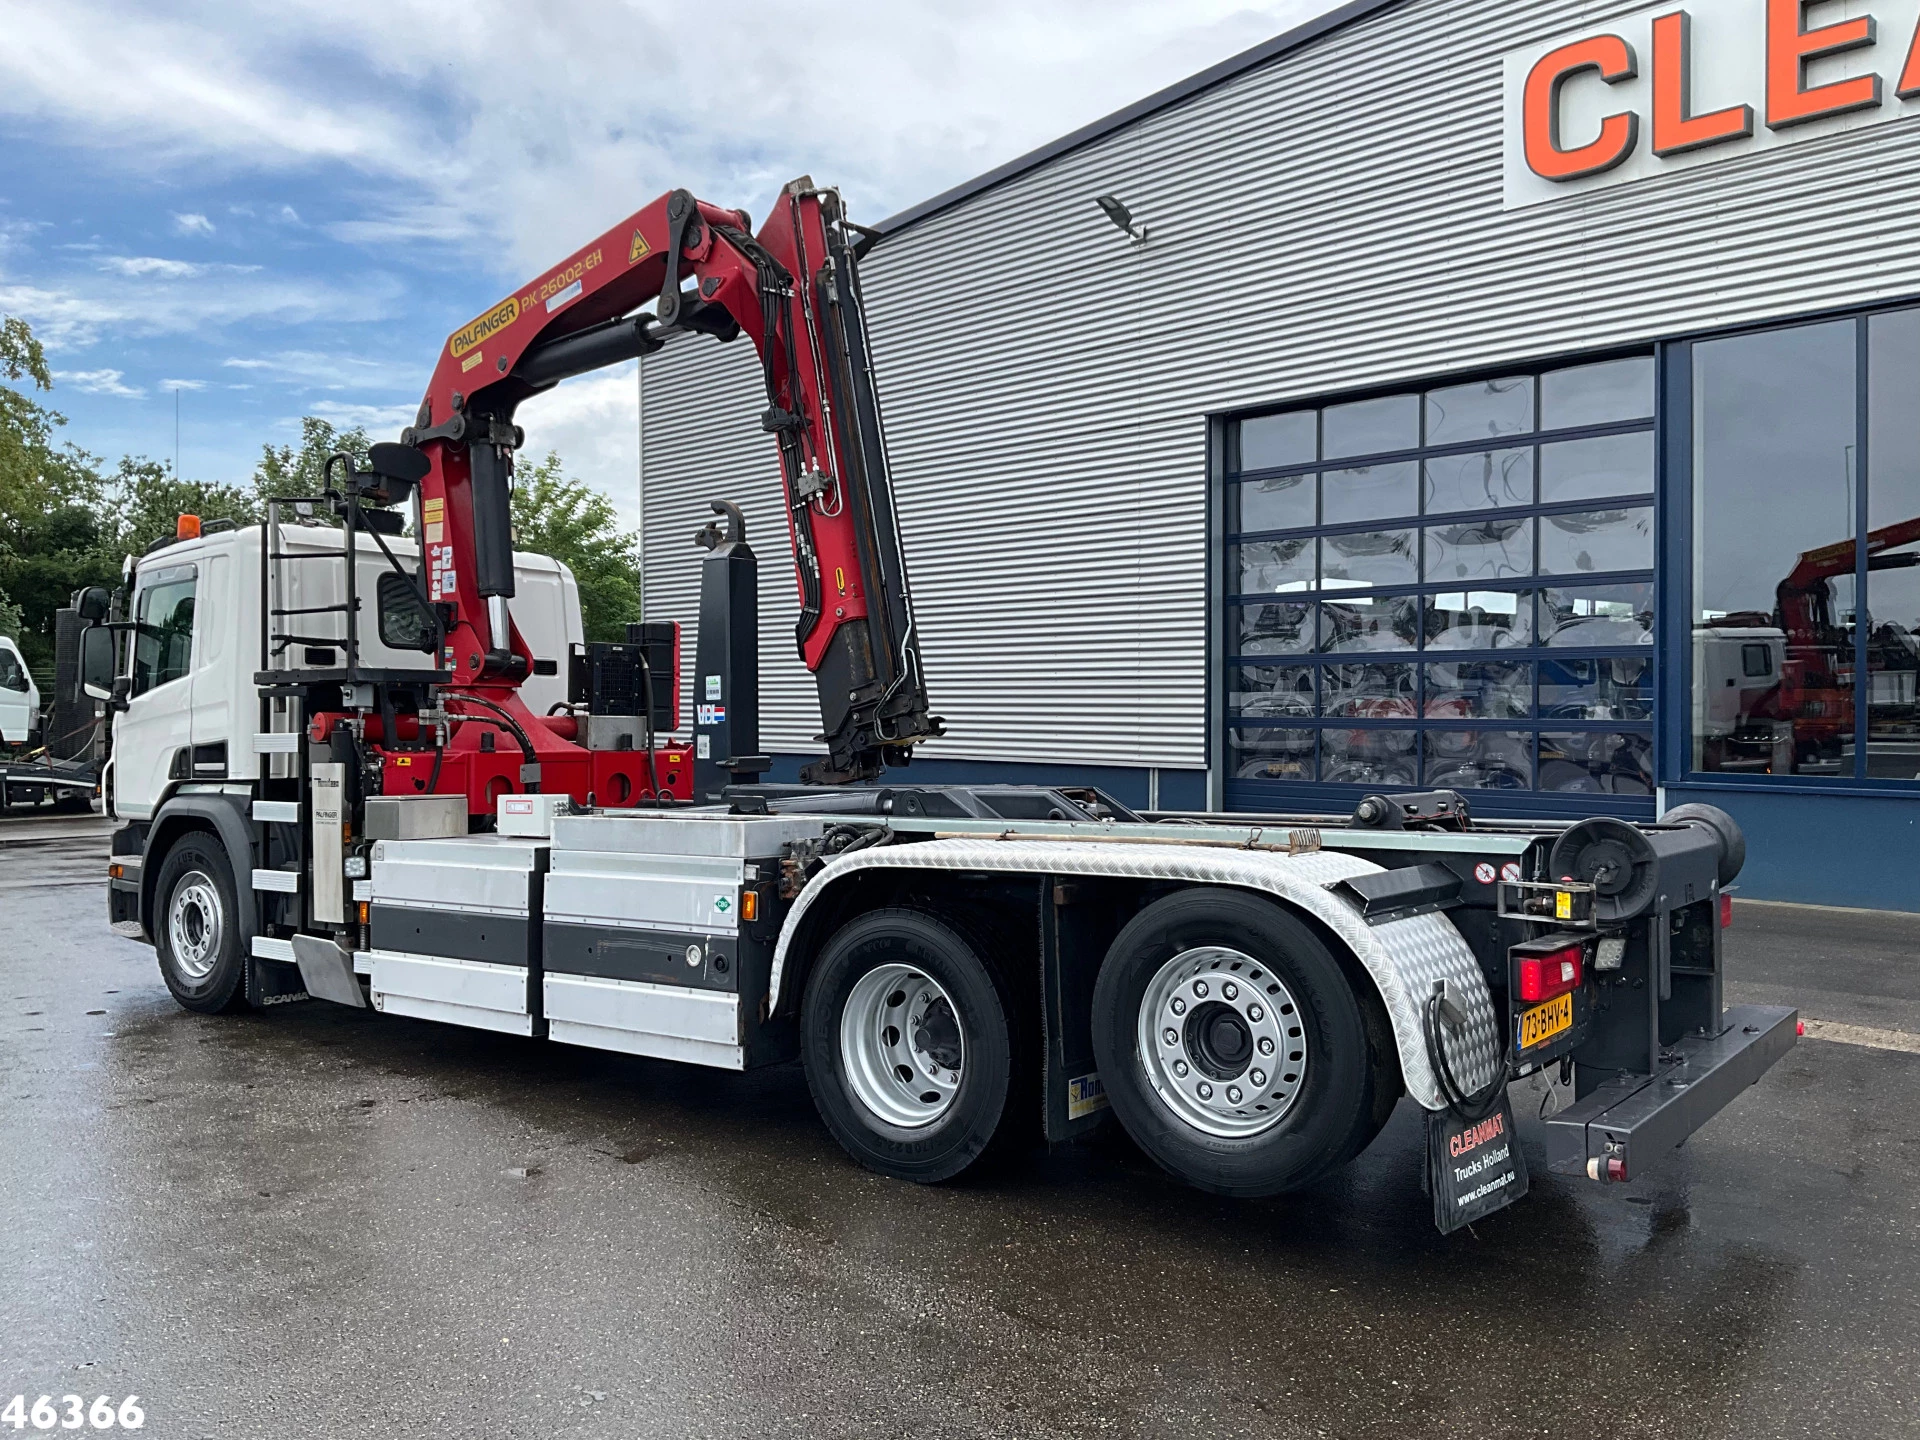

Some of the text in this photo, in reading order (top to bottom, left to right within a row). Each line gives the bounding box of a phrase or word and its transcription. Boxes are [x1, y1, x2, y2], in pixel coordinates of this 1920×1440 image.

[1523, 0, 1920, 182] CLE
[454, 303, 516, 353] PALFINGER
[521, 291, 538, 313] PK
[697, 704, 718, 725] VDL
[263, 991, 309, 1005] SCANIA
[1526, 999, 1569, 1042] 73-BHV-4
[1450, 1113, 1504, 1157] CLEANMAT
[1454, 1144, 1509, 1182] Trucks Holland
[1458, 1170, 1515, 1207] www.cleanmat.eu
